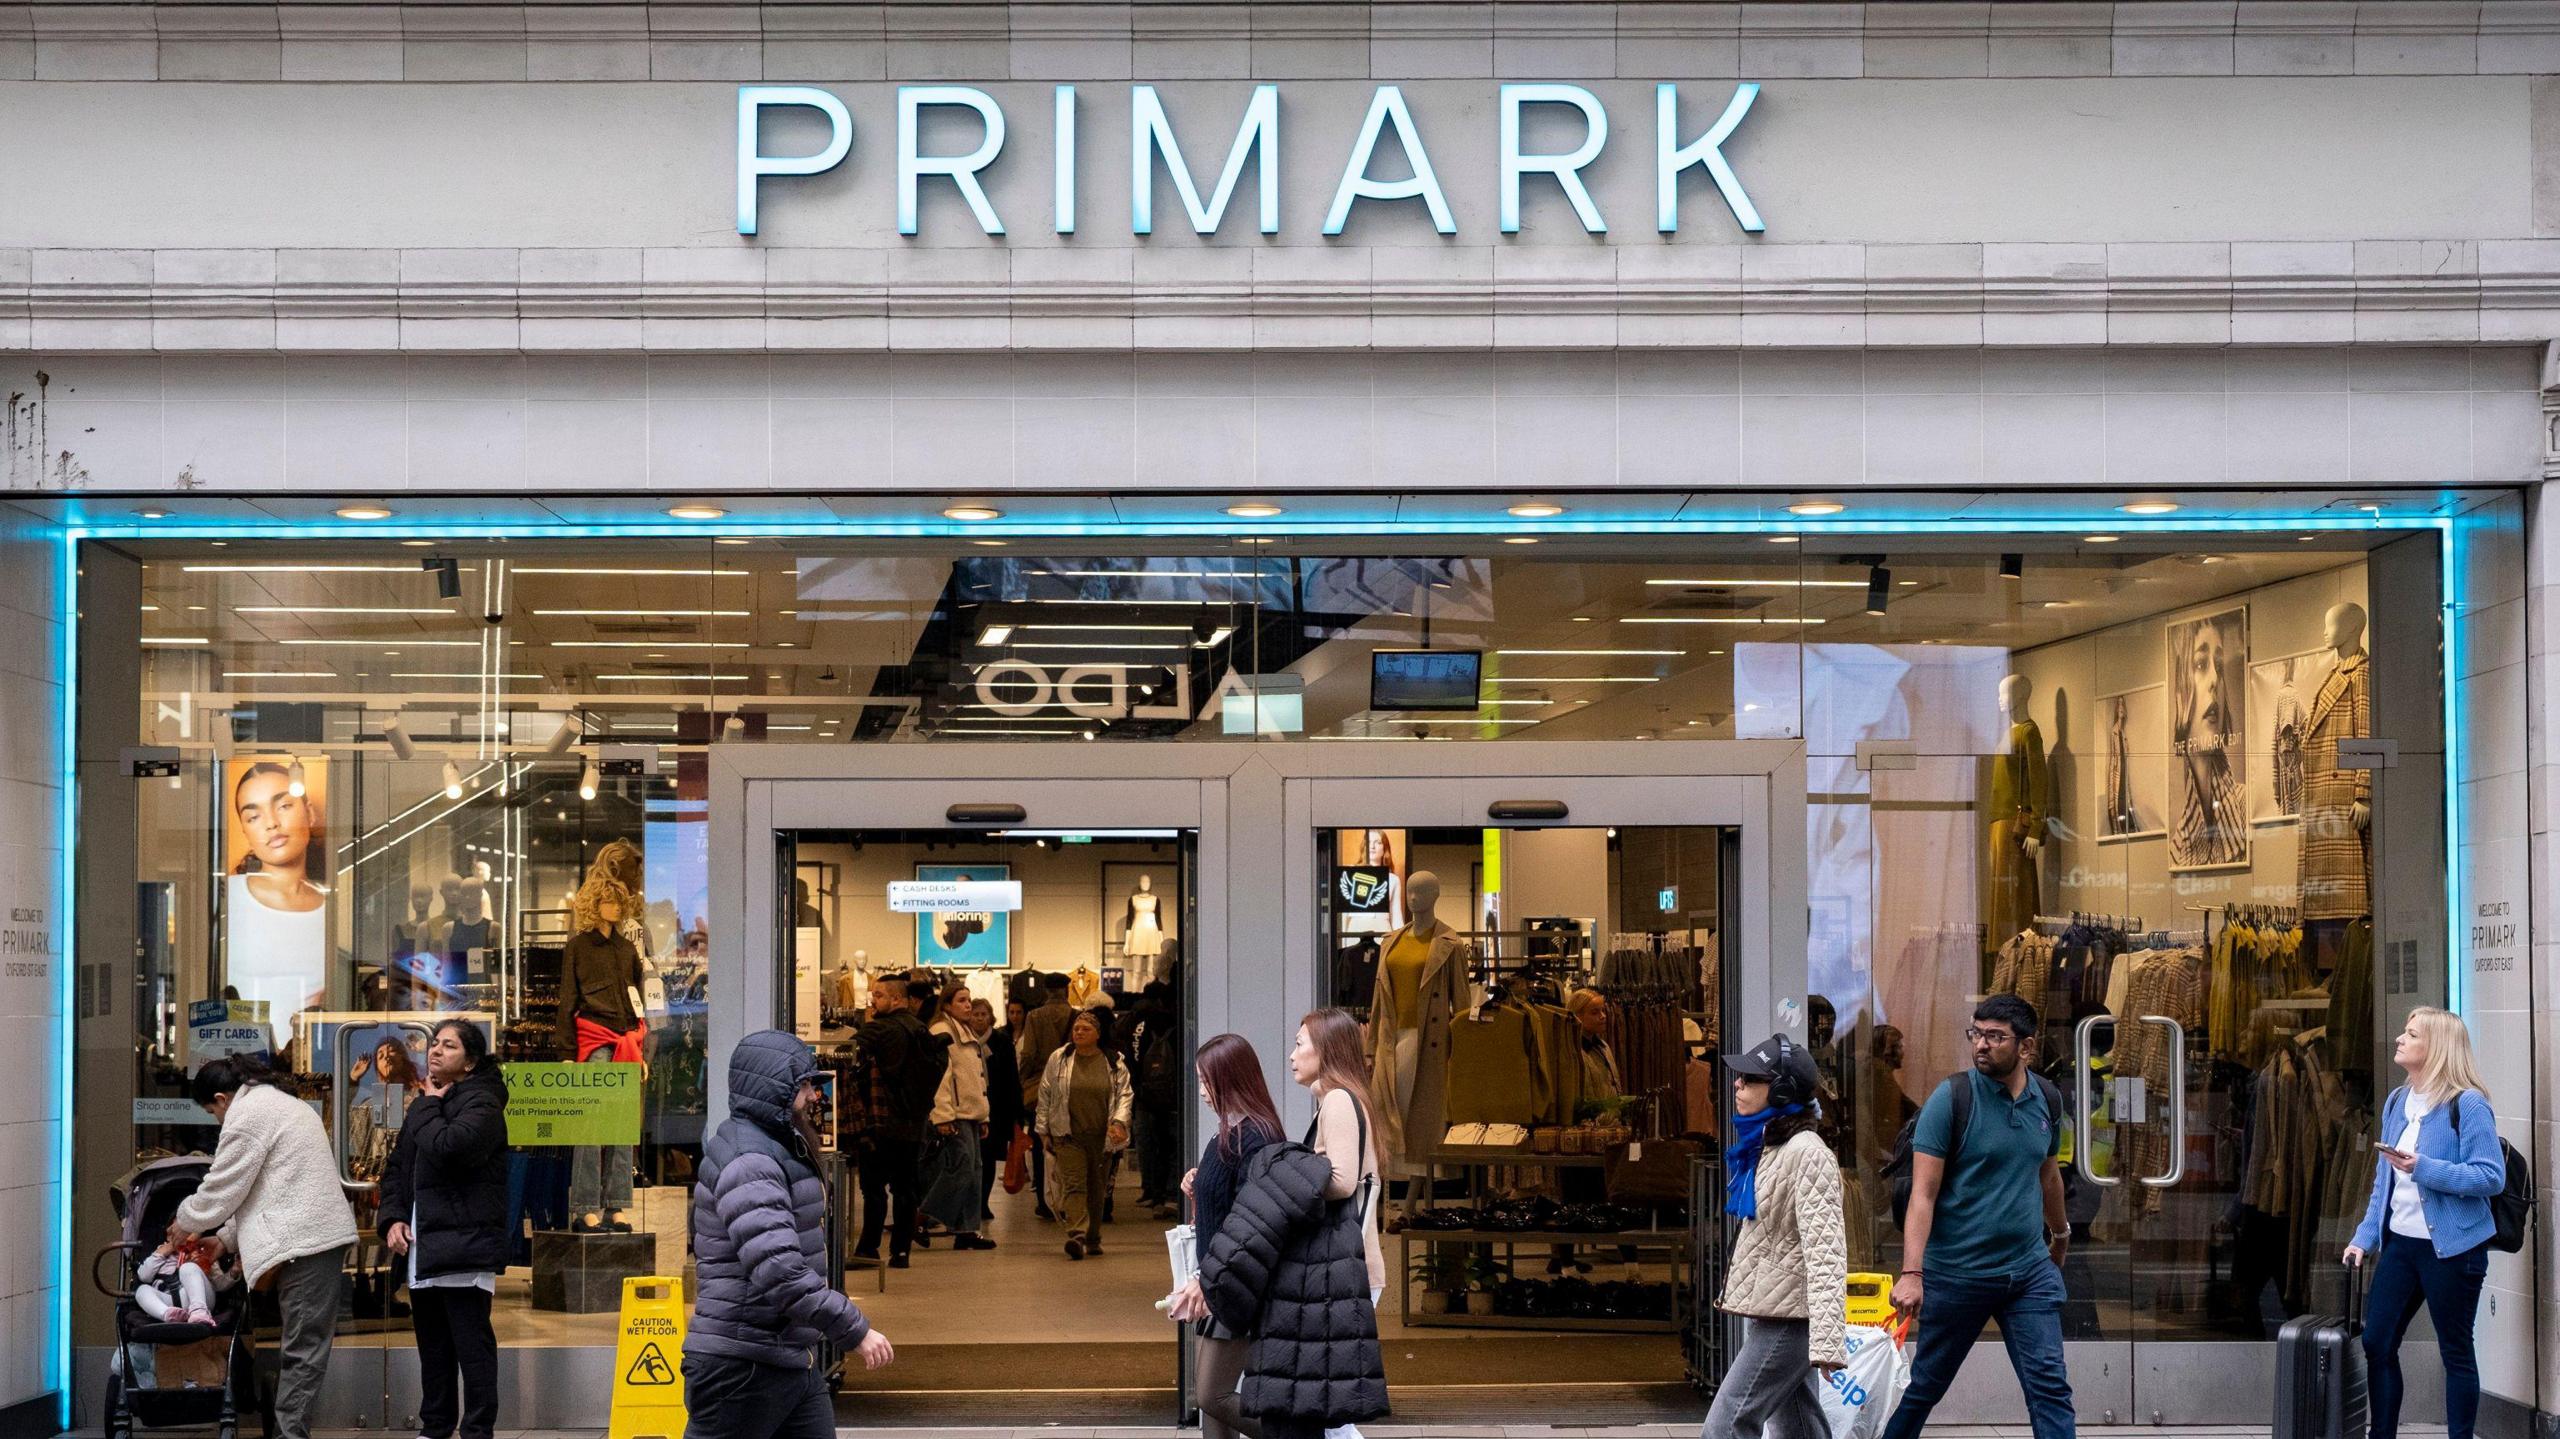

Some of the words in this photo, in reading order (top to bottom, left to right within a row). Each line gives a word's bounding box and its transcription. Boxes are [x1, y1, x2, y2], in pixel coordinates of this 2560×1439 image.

[738, 84, 1765, 236] PRIMARK
[2174, 740, 2186, 755] THE
[2188, 733, 2225, 755] PRIMARK
[2228, 731, 2242, 746] EDIT
[2478, 903, 2502, 917] WELCOME
[2, 930, 50, 956] PRIMARK
[2472, 924, 2516, 950] PRIMARK
[199, 1028, 221, 1039] GIFT
[225, 1028, 259, 1039] CARDS
[506, 1073, 516, 1087] K
[523, 1073, 534, 1087] &
[541, 1073, 628, 1087] COLLECT
[136, 1100, 160, 1112] Shop
[163, 1100, 191, 1111] online
[510, 1096, 548, 1105] available
[549, 1097, 557, 1105] in
[559, 1096, 575, 1105] this
[578, 1097, 602, 1105] store.
[506, 1108, 525, 1116] Visit
[528, 1108, 583, 1116] Primark.com
[633, 1318, 672, 1326] CAUTION
[627, 1327, 644, 1336] WET
[648, 1327, 678, 1336] FLOOR
